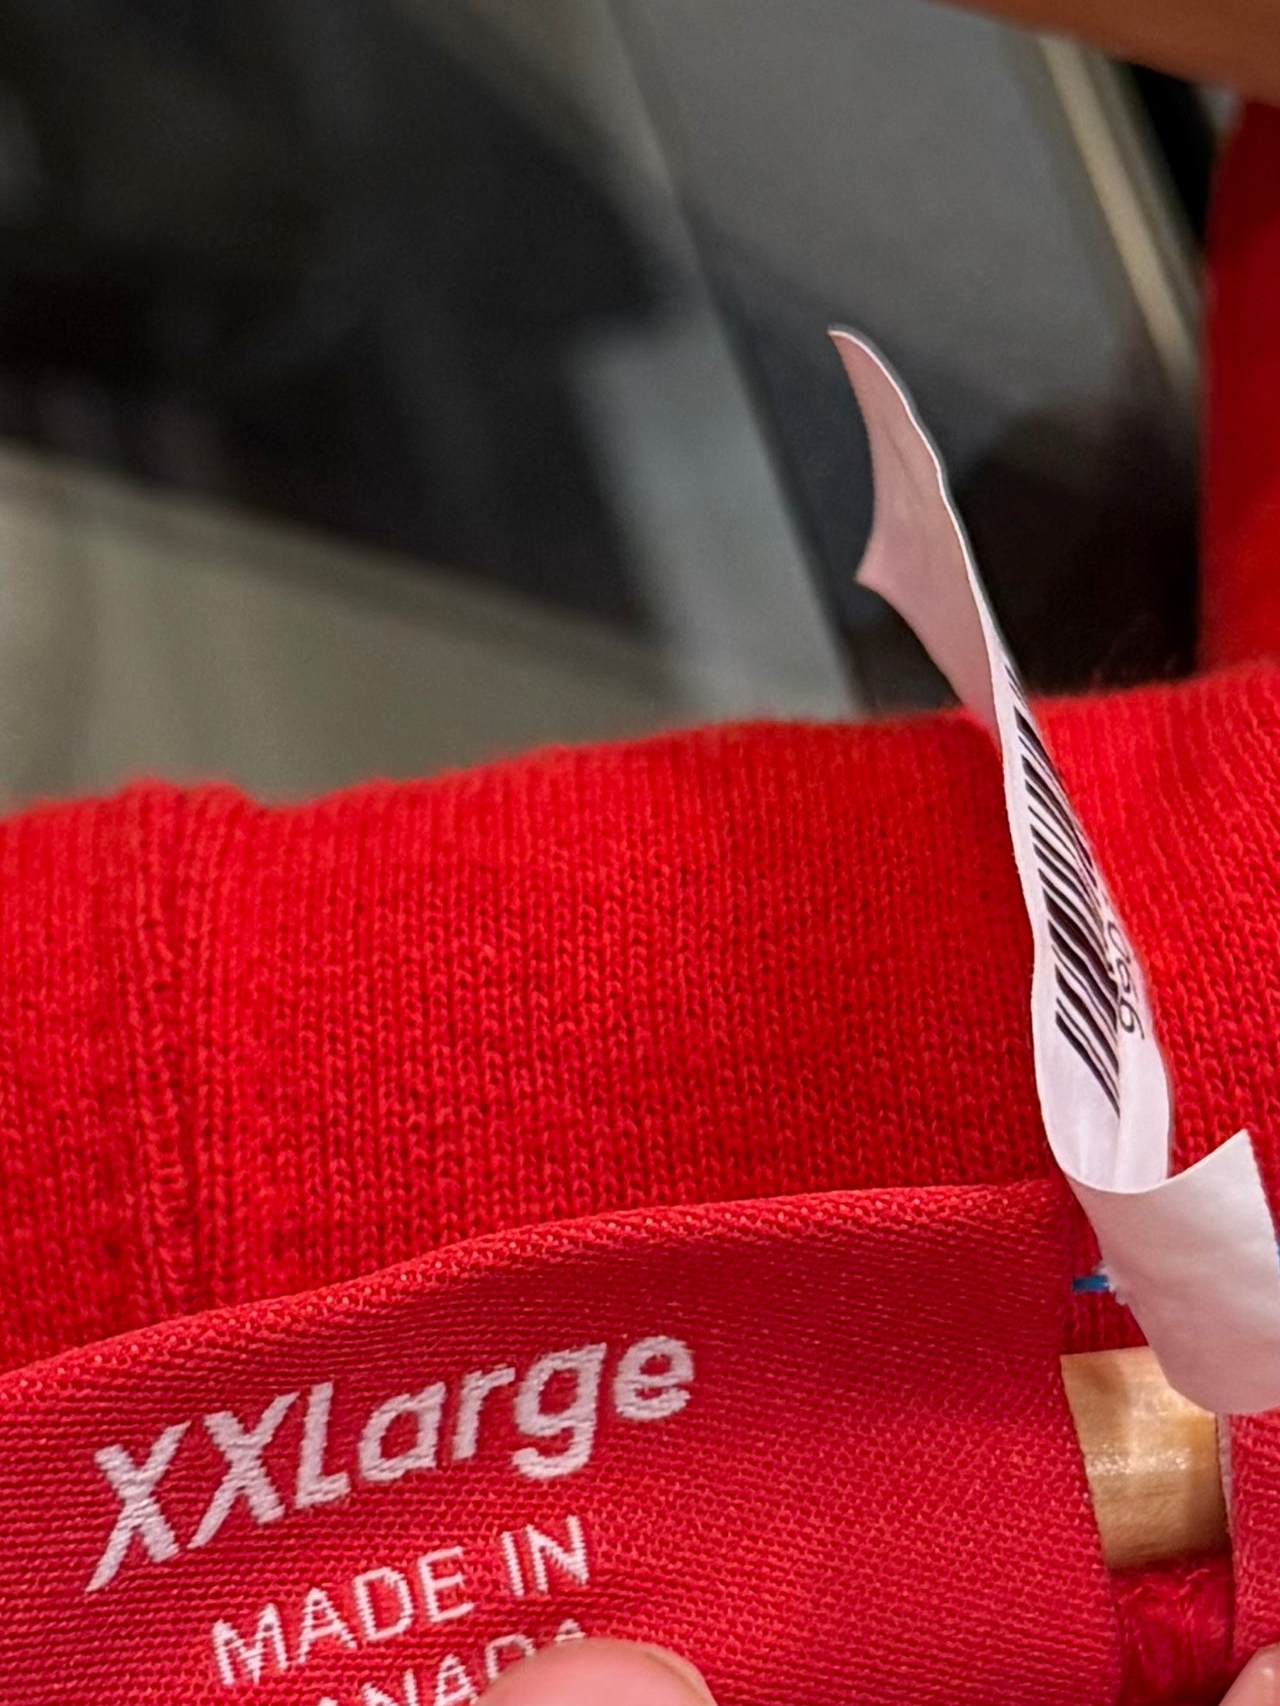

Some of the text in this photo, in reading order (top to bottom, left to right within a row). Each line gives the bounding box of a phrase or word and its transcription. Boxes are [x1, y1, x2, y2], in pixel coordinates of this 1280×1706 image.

[84, 1334, 696, 1593] XXLarge
[212, 1515, 589, 1686] MADE IN
